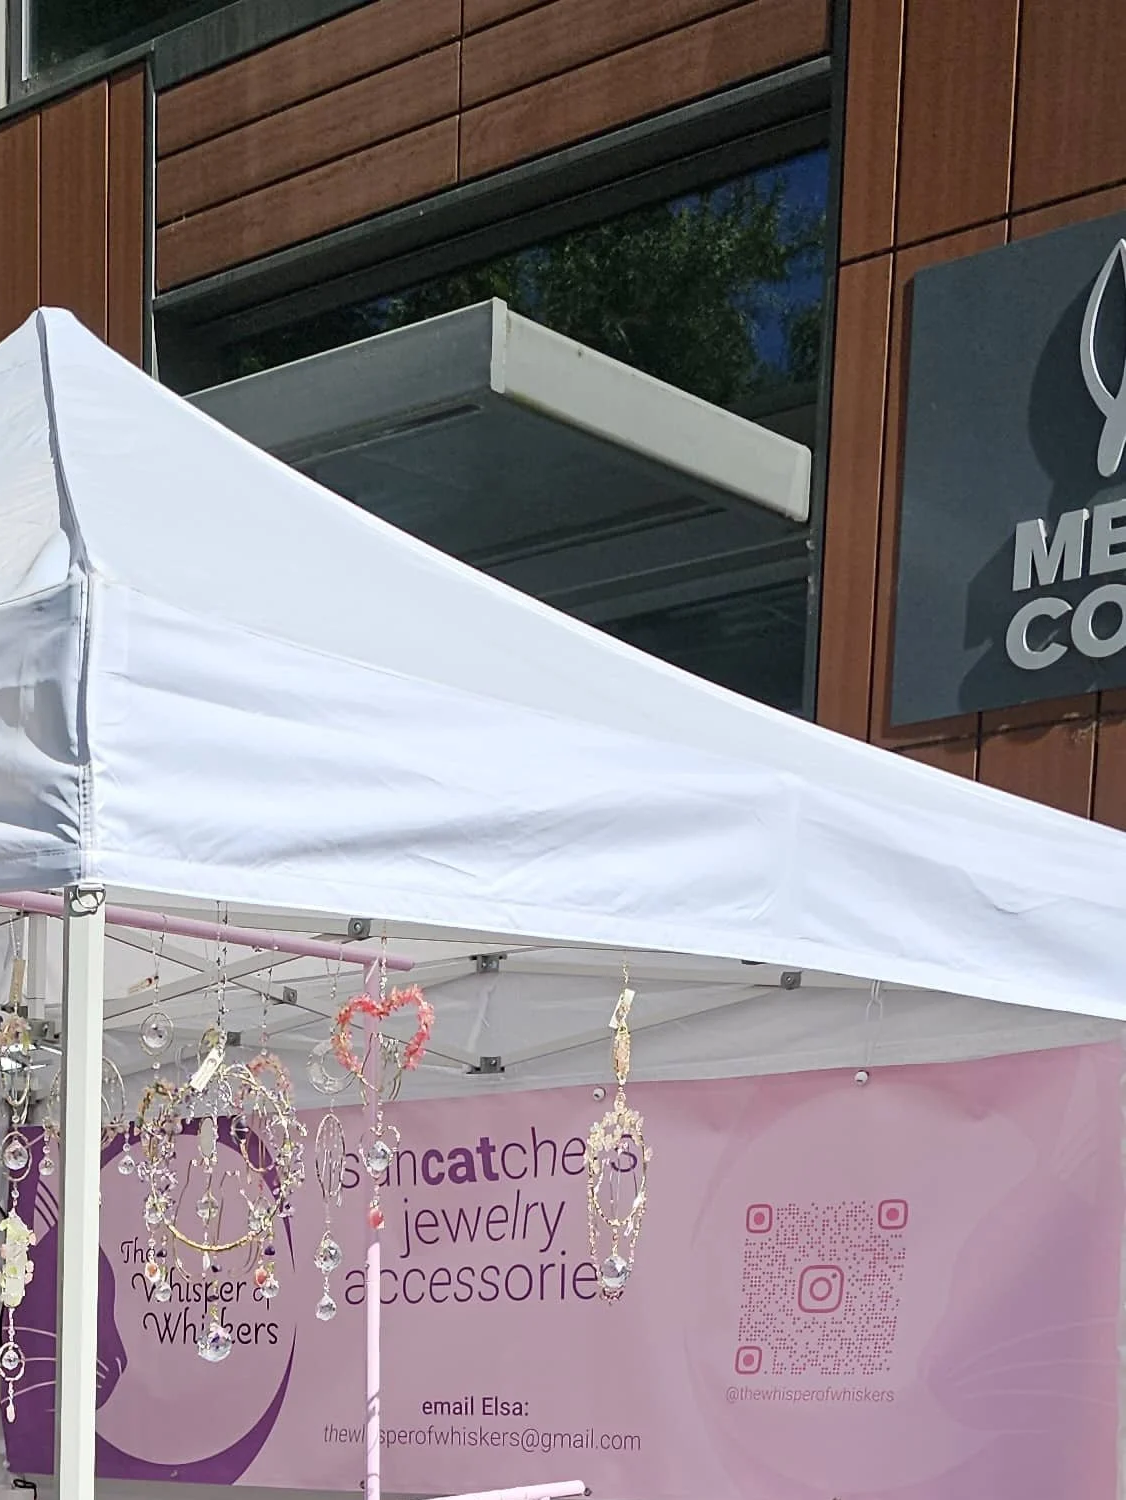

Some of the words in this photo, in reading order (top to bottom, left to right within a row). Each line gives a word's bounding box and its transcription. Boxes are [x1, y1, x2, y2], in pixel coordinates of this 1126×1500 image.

[1012, 498, 1126, 591] ME
[1005, 584, 1126, 670] CO
[399, 1189, 565, 1258] jewelry
[344, 1250, 610, 1305] accessorie
[143, 1306, 279, 1345] Whikers
[421, 1396, 475, 1417] email
[481, 1396, 530, 1417] Elsa:
